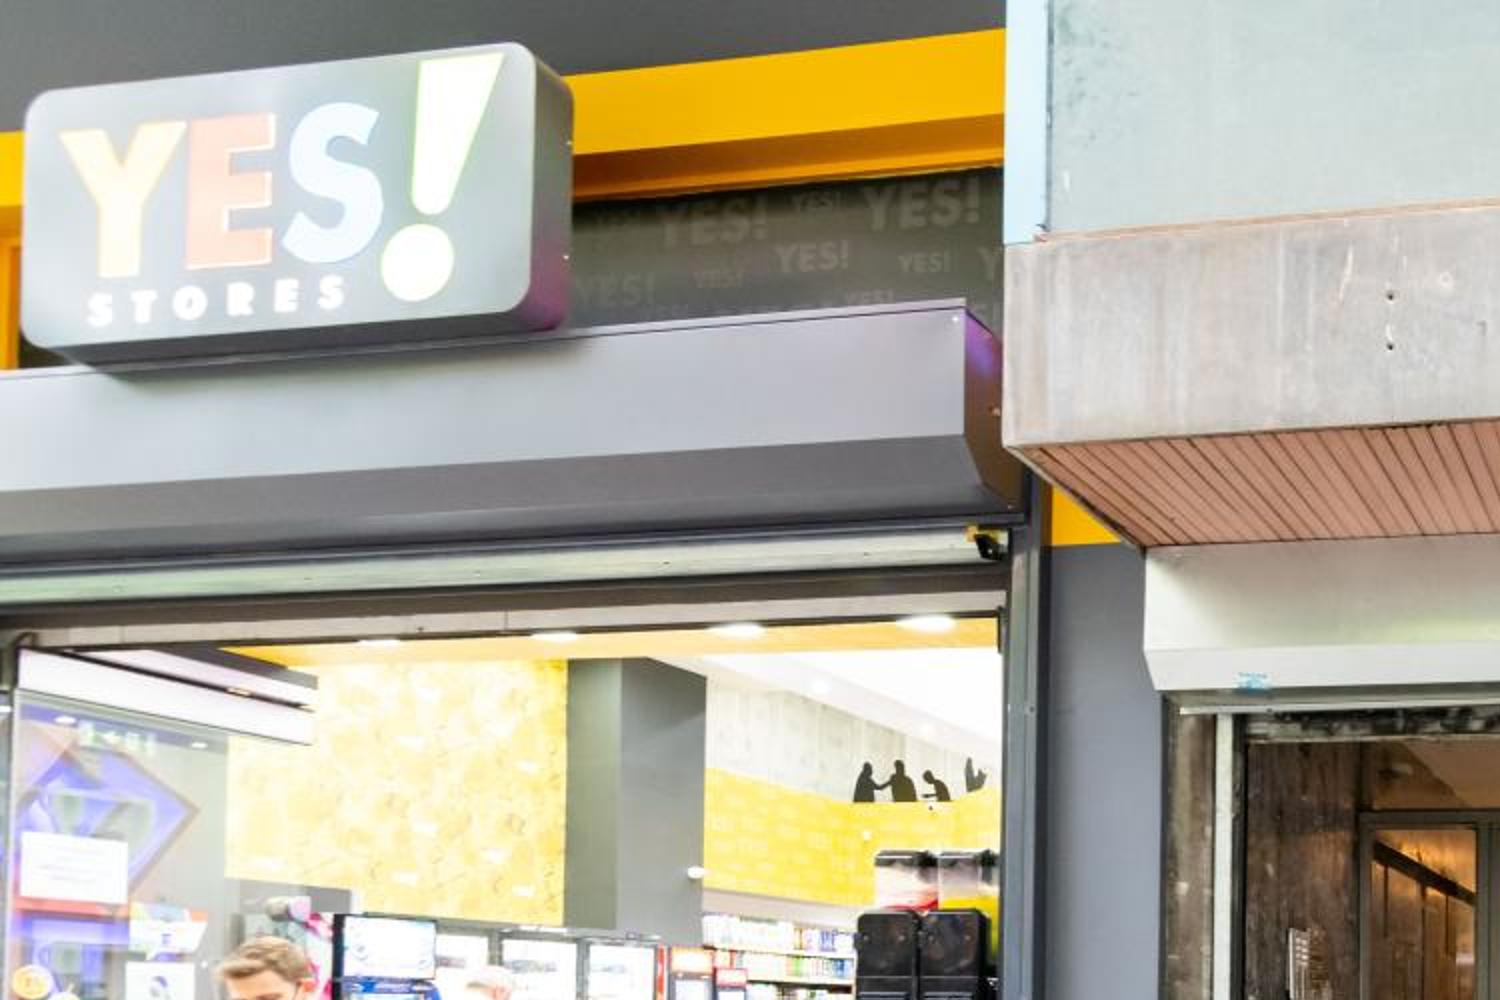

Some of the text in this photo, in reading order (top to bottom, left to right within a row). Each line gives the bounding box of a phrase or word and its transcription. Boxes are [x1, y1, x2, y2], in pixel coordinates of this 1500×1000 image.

[59, 53, 503, 302] YES!
[864, 177, 980, 232] YES!
[774, 240, 849, 272] YES!
[898, 250, 951, 272] YES!
[88, 275, 346, 328] STORES
